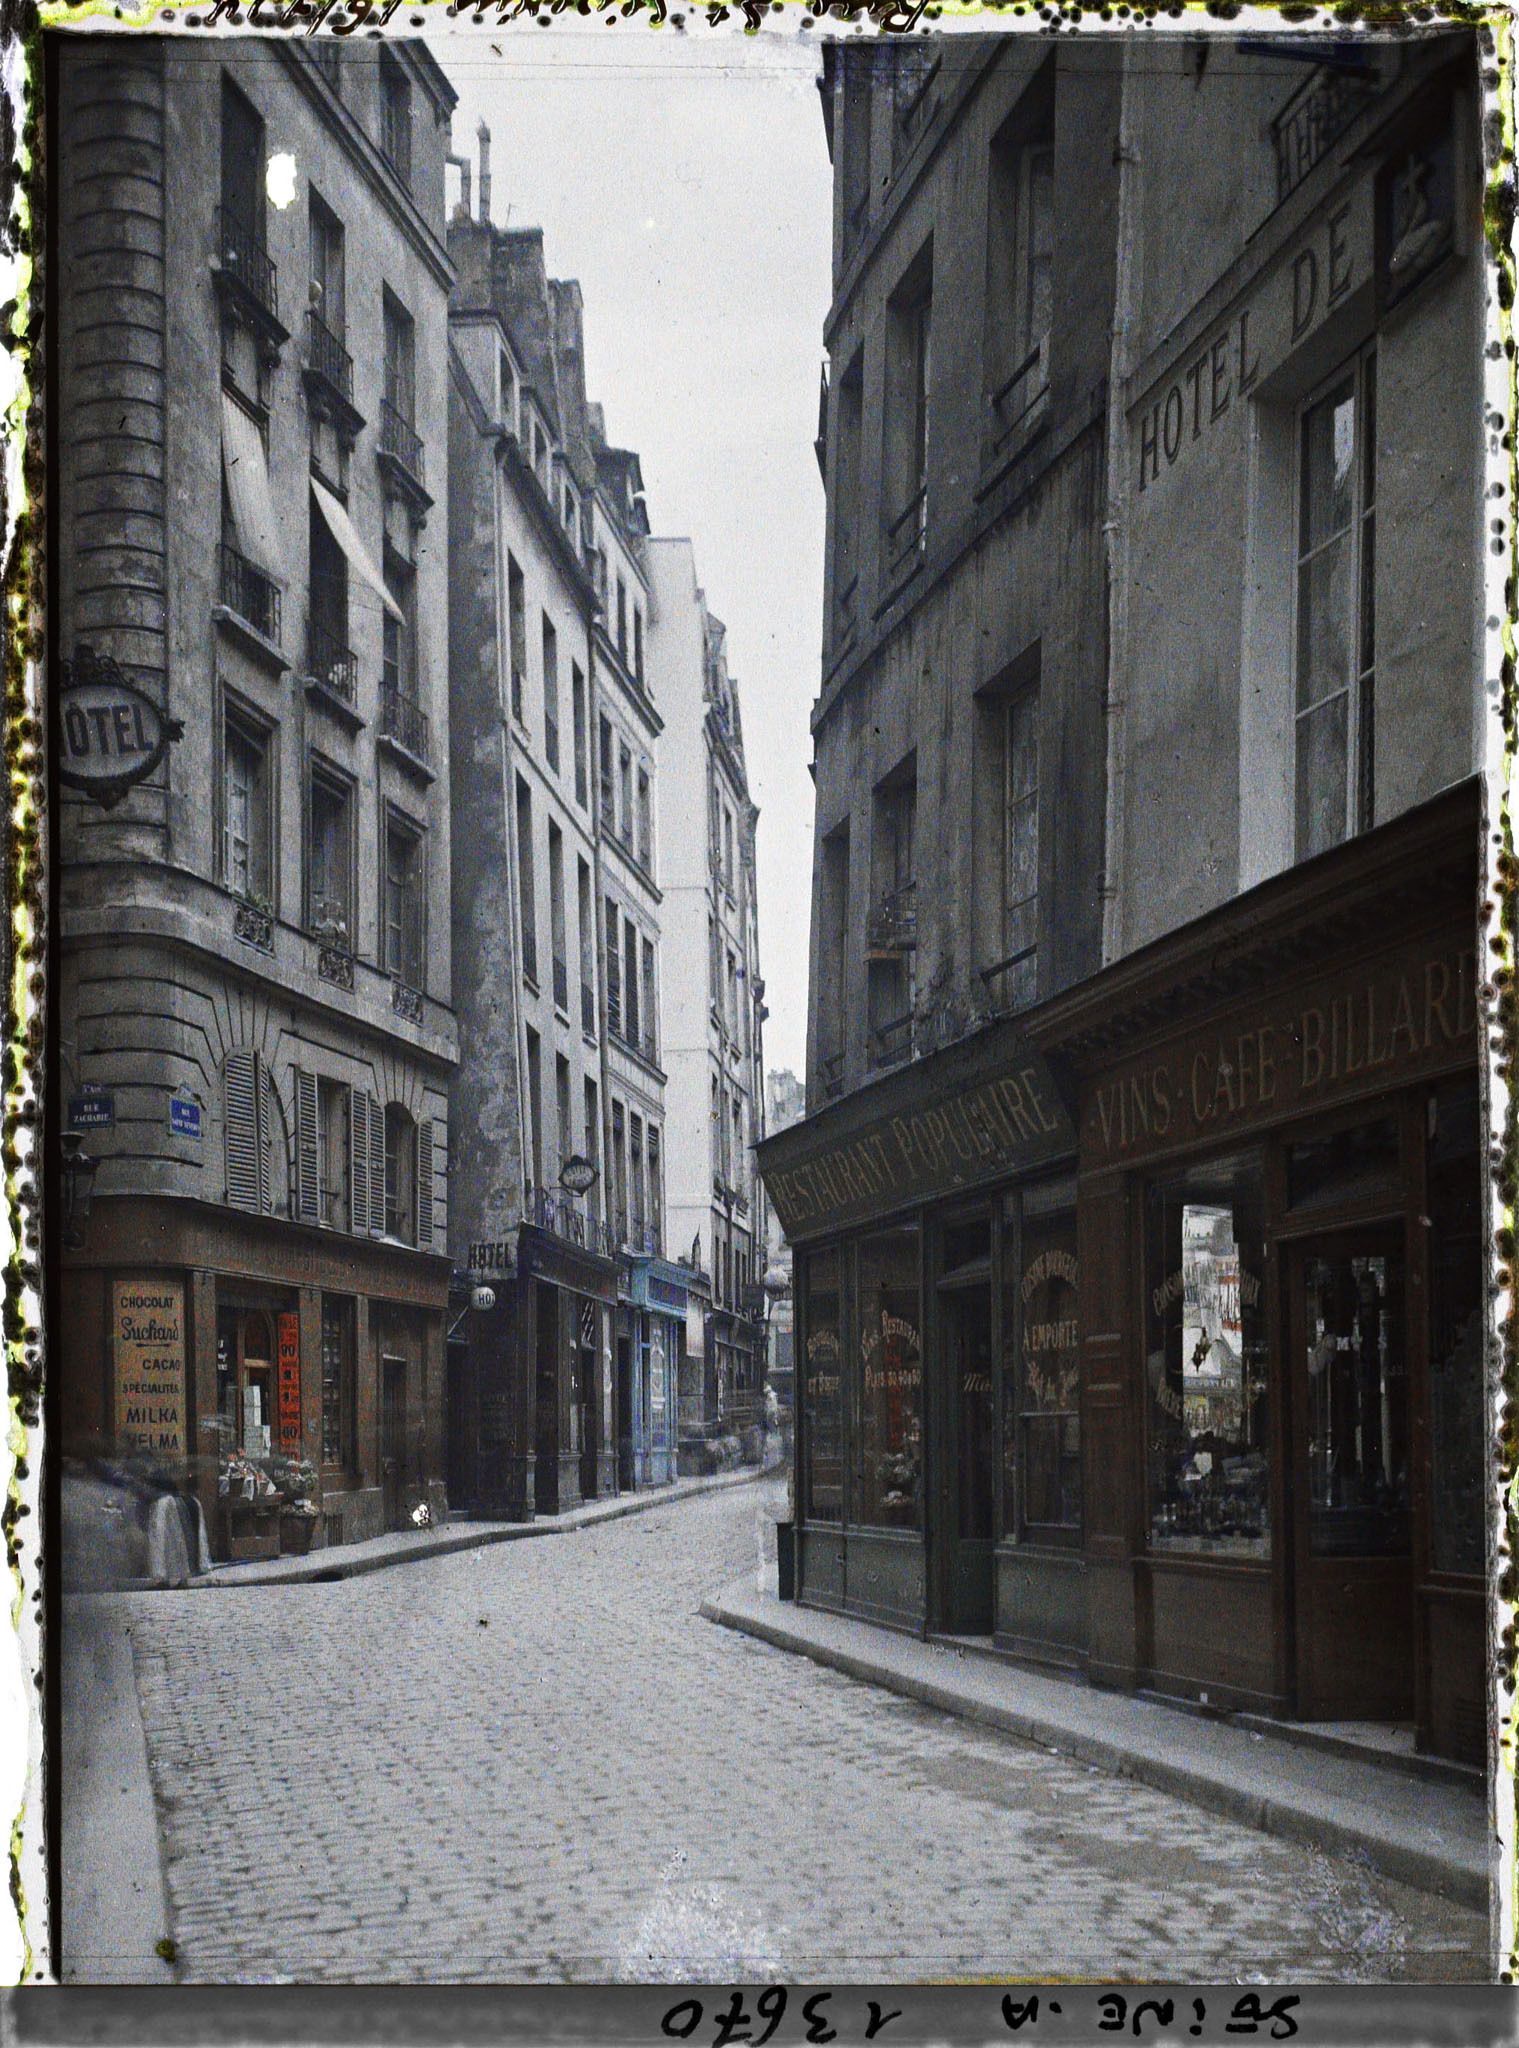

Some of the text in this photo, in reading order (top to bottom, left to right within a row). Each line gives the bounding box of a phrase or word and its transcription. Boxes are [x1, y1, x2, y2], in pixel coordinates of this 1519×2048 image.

[1139, 200, 1352, 492] HOTEL DE
[59, 702, 154, 757] ÔTEL
[1096, 1065, 1171, 1150] VINS
[767, 1068, 1058, 1223] RESTAURANT POPULAIRE
[120, 1296, 174, 1309] CHOCOLAT
[121, 1316, 180, 1341] Suchard
[126, 1407, 178, 1424] MILKA
